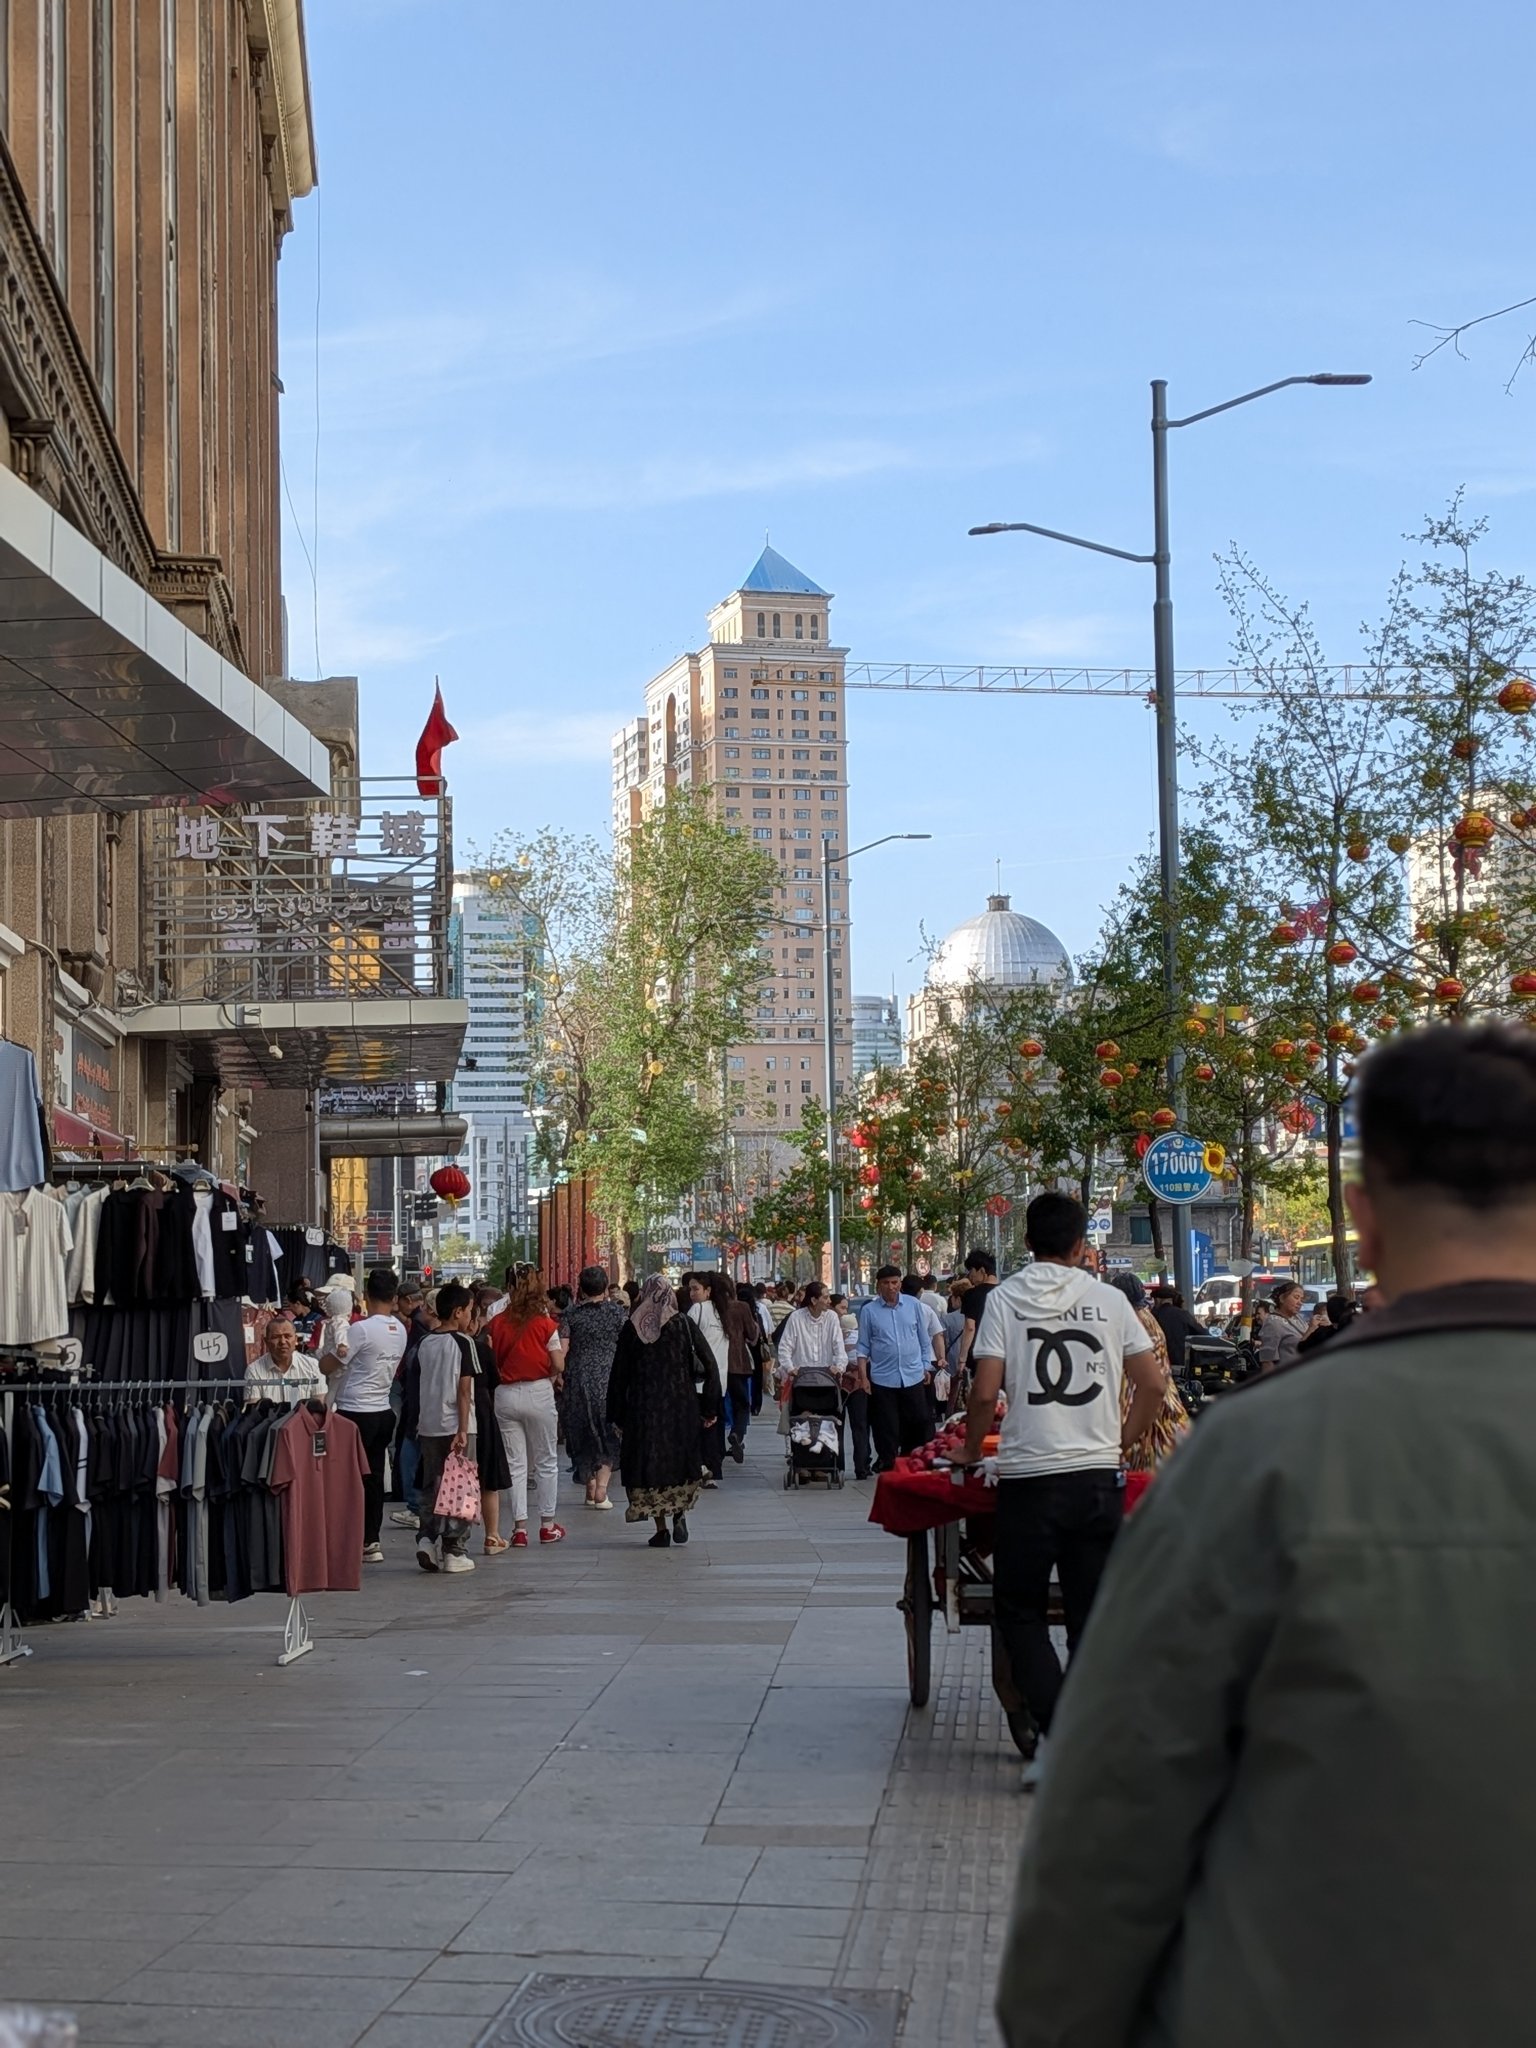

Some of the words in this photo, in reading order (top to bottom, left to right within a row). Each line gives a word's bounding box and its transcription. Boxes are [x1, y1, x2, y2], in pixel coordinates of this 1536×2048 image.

[175, 810, 427, 860] 地下鞋城
[1151, 1151, 1204, 1175] 170007
[200, 1334, 223, 1356] 45
